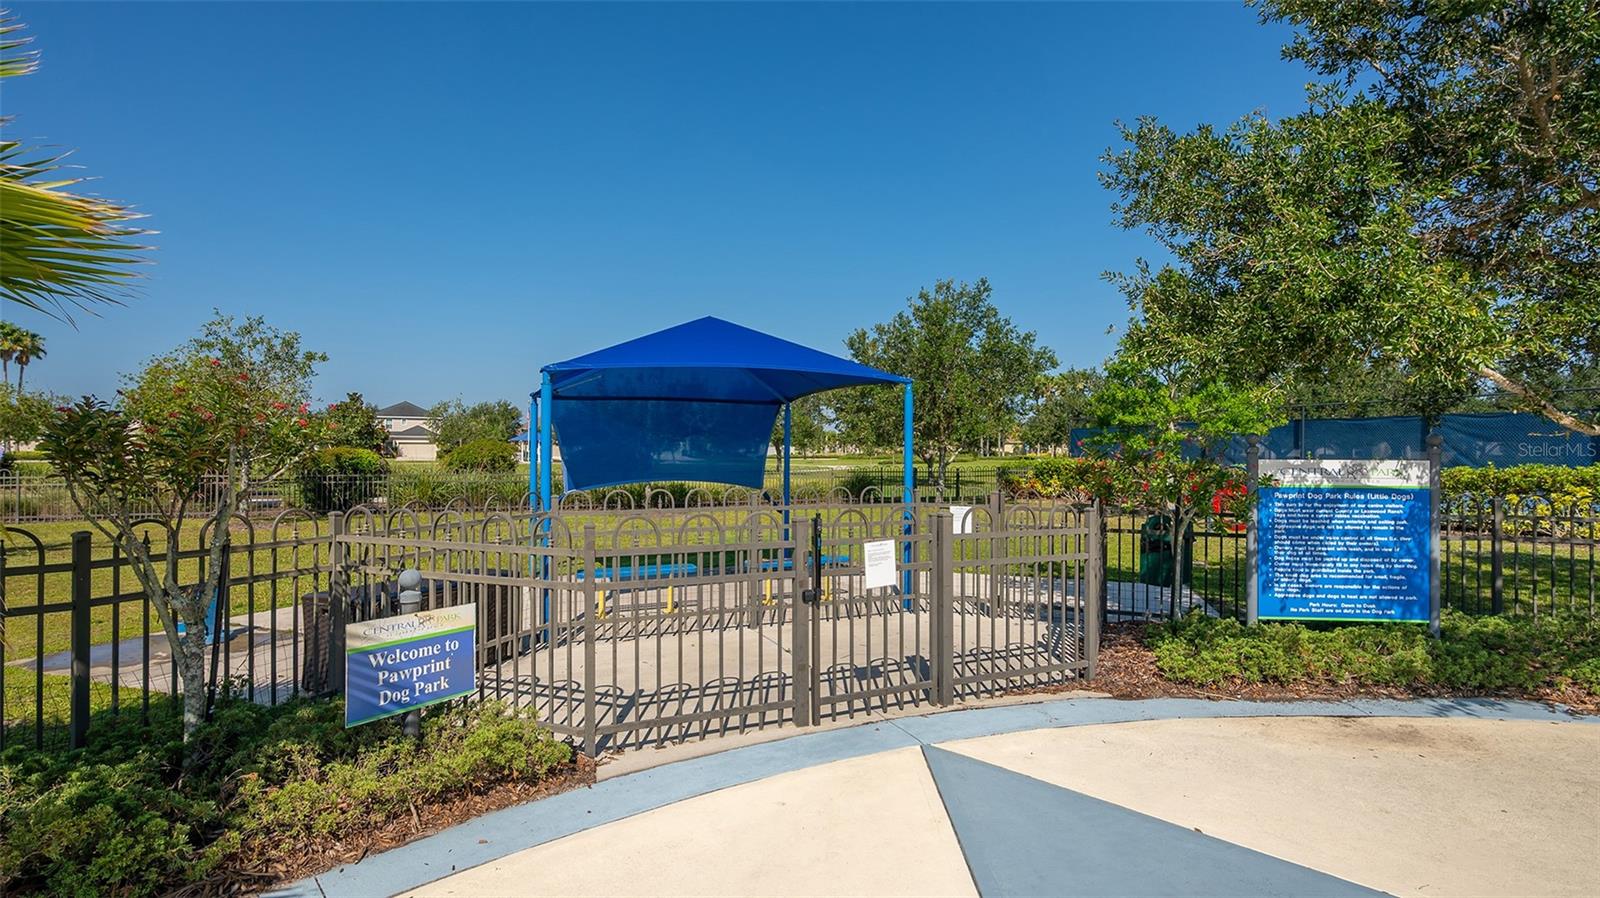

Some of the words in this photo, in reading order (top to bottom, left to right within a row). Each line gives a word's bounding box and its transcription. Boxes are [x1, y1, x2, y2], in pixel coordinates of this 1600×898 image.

[1274, 491, 1305, 500] Pawprint
[1307, 492, 1323, 500] Dog
[1325, 492, 1342, 500] Park
[1344, 492, 1365, 500] Rules
[1367, 492, 1389, 500] (Little
[1391, 493, 1415, 501] Dogs)
[363, 621, 417, 637] CENTRAL
[436, 613, 461, 623] PARK
[368, 643, 441, 668] Welcome
[445, 640, 459, 652] to
[377, 656, 451, 686] Pawprint
[379, 688, 410, 706] Dog
[414, 676, 450, 697] Park
